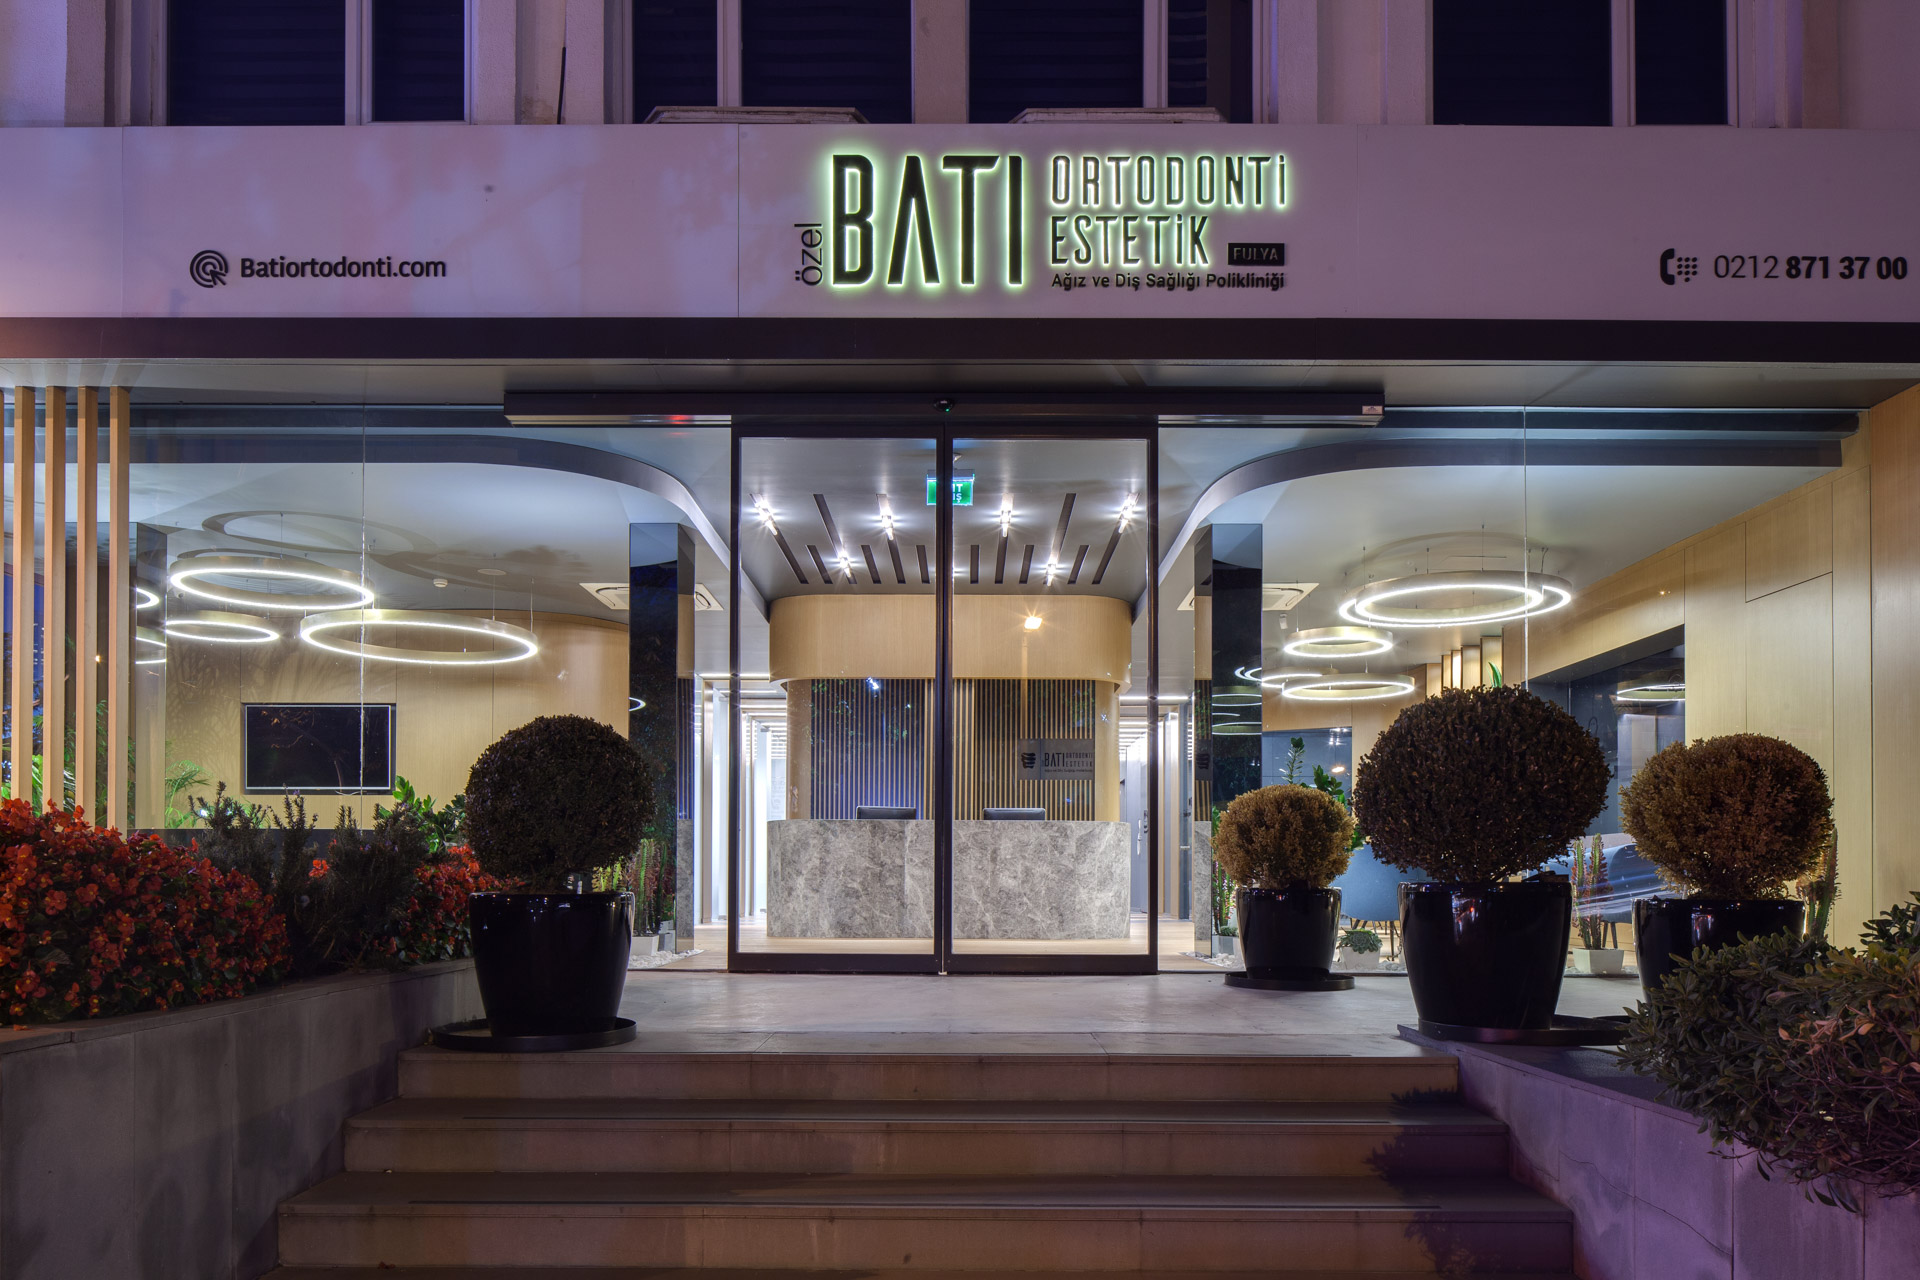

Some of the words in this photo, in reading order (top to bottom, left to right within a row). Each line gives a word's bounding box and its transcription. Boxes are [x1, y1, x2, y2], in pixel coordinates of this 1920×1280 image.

[832, 154, 1023, 285] BATI
[240, 255, 447, 278] Batiortodonti.com
[794, 223, 823, 286] özel
[1713, 254, 1780, 279] 0212
[1785, 255, 1830, 280] 871
[1838, 255, 1871, 280] 37
[1875, 256, 1908, 280] 00
[1051, 272, 1087, 292] Ağız
[1092, 276, 1111, 288] ve
[1115, 272, 1141, 292] Diş
[1146, 272, 1200, 292] Sağlığı
[1206, 272, 1285, 292] Polikliniği
[1044, 752, 1065, 767] BATI
